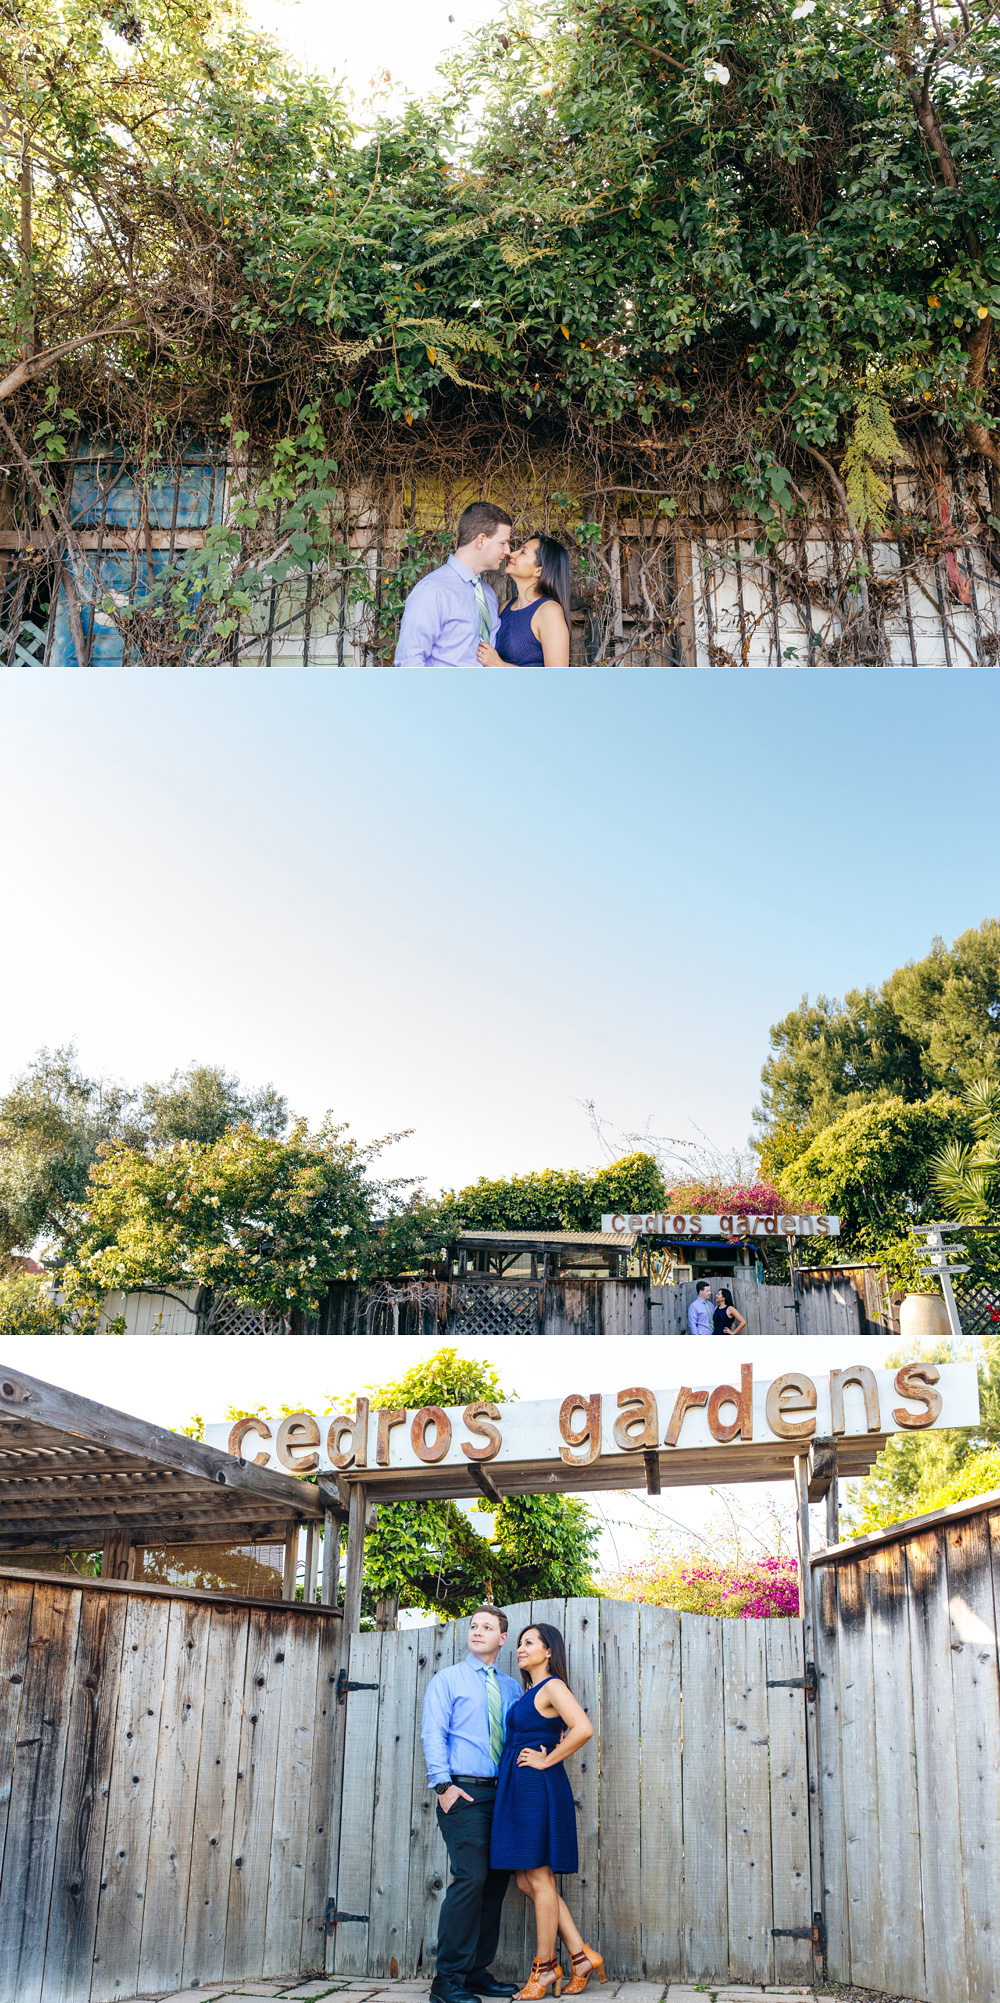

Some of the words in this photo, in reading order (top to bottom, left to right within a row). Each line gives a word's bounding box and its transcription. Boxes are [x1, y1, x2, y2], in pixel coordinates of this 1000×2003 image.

[611, 1211, 702, 1234] cedros
[719, 1211, 830, 1239] gardens
[228, 1397, 502, 1472] cedros
[558, 1362, 943, 1467] gardens
